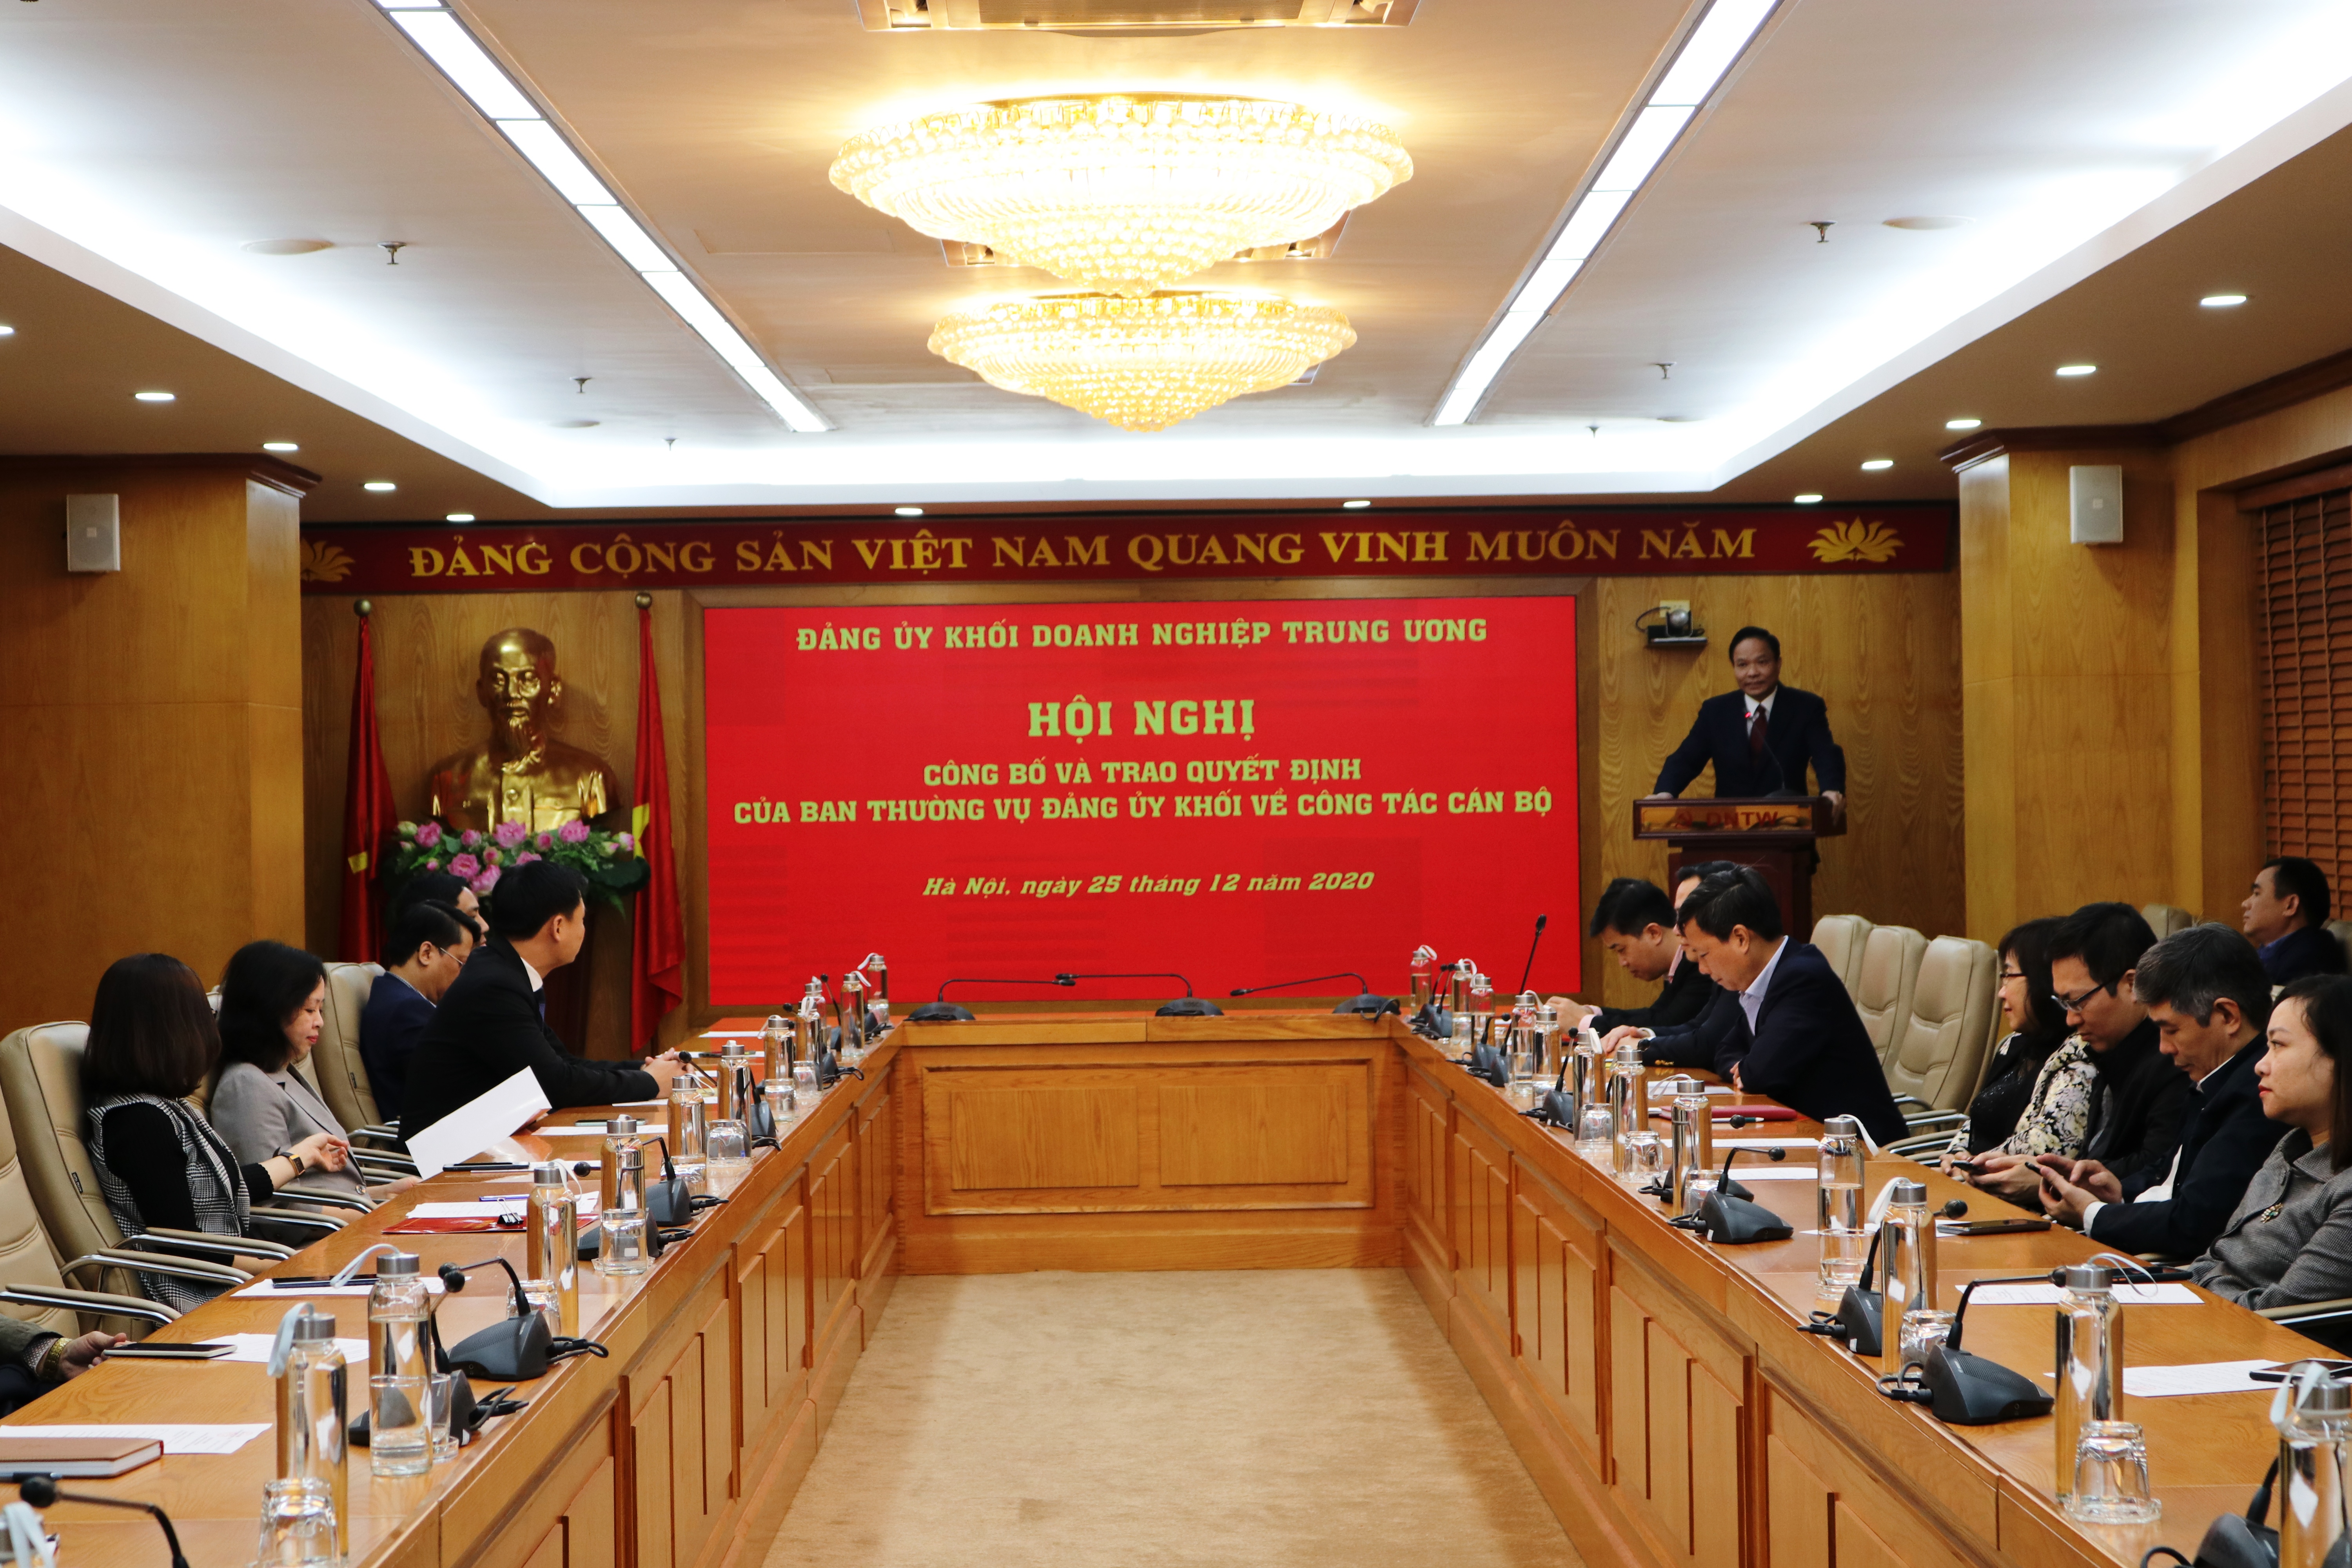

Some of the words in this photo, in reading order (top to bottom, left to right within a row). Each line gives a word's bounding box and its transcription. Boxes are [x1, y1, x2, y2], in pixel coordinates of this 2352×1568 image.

[409, 536, 552, 576] ĐẢNG
[570, 532, 714, 579] CỘNG
[737, 529, 833, 570] SẢN
[852, 529, 972, 575] VIỆT
[992, 536, 1110, 566] NAM
[1128, 534, 1305, 571] QUANG
[1319, 532, 1448, 563] VINH
[1466, 519, 1619, 561] MUÔN
[1639, 521, 1756, 558] NĂM
[796, 622, 880, 650] ĐẢNG
[894, 621, 933, 649] ỦY
[945, 619, 1018, 648] KHỐI
[1033, 624, 1138, 647] DOANH
[1152, 618, 1270, 648] NGHIỆP
[1283, 620, 1389, 643] TRUNG
[1404, 619, 1486, 642] ƯƠNG
[1028, 695, 1112, 744] HỘI
[1134, 700, 1254, 741] NGHỊ
[924, 759, 998, 786] CÔNG
[1009, 756, 1046, 784] BỐ
[1055, 757, 1092, 783] VÀ
[1102, 761, 1176, 782] TRAO
[1187, 753, 1279, 783] QUYẾT
[1290, 759, 1361, 784] ĐỊNH
[735, 796, 790, 824] CỦA
[800, 801, 857, 822] BAN
[867, 794, 984, 821] THƯỜNG
[994, 798, 1031, 823] VỤ
[1041, 793, 1117, 818] ĐẢNG
[1129, 791, 1165, 818] ỦY
[1175, 788, 1241, 817] KHỐI
[1251, 788, 1287, 815] VỀ
[1298, 789, 1372, 815] CÔNG
[1382, 789, 1437, 814] TÁC
[1448, 788, 1504, 813] CÁN
[1515, 786, 1551, 816] BỘ
[923, 878, 956, 895] Hà
[1021, 876, 1082, 898] ngày
[1087, 875, 1122, 893] 25
[1130, 874, 1201, 896] tháng
[1210, 874, 1240, 891] 12
[1247, 875, 1301, 891] năm
[1308, 872, 1374, 890] 2020
